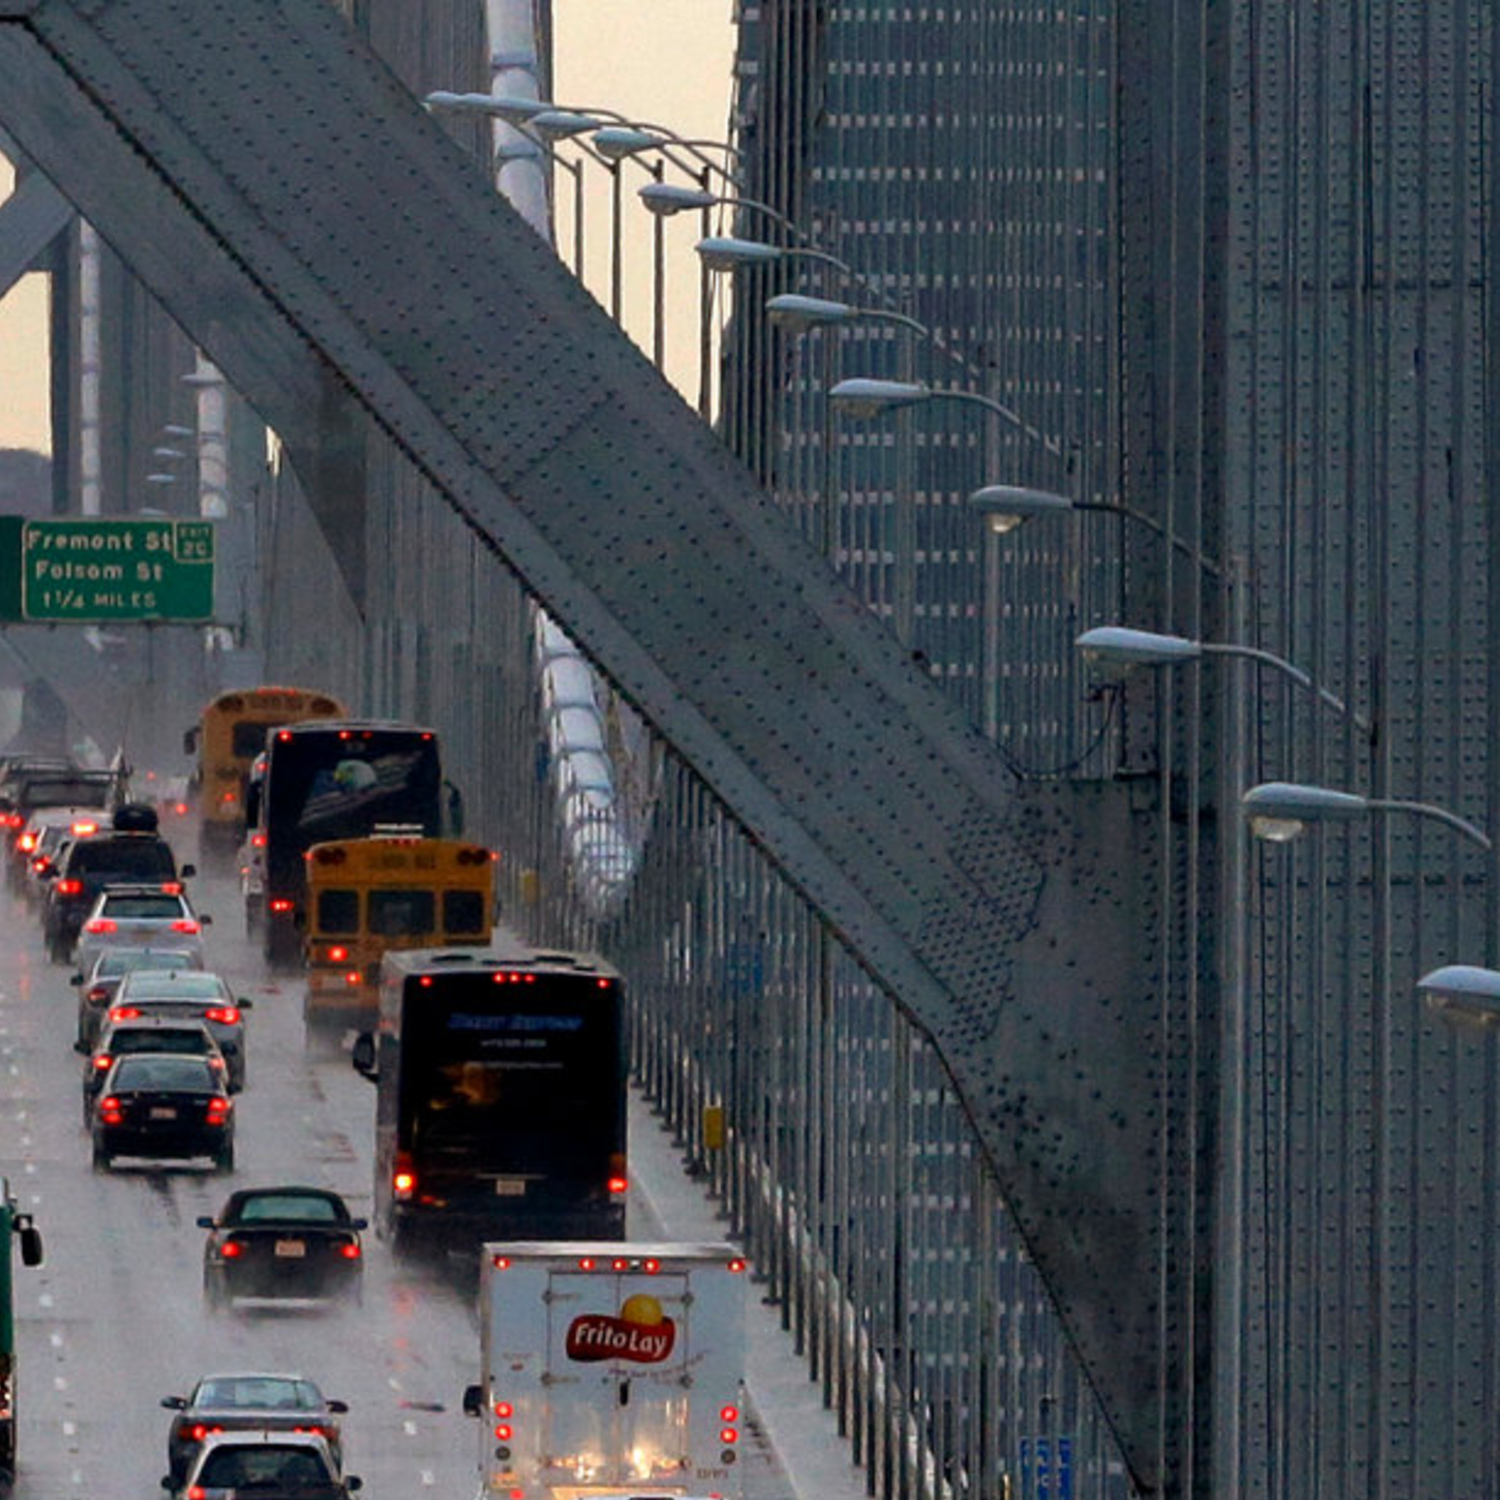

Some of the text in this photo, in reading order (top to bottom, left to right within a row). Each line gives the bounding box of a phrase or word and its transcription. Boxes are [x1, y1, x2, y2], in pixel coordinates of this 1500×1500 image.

[28, 530, 171, 551] Fremont St
[36, 560, 164, 581] Folsom St
